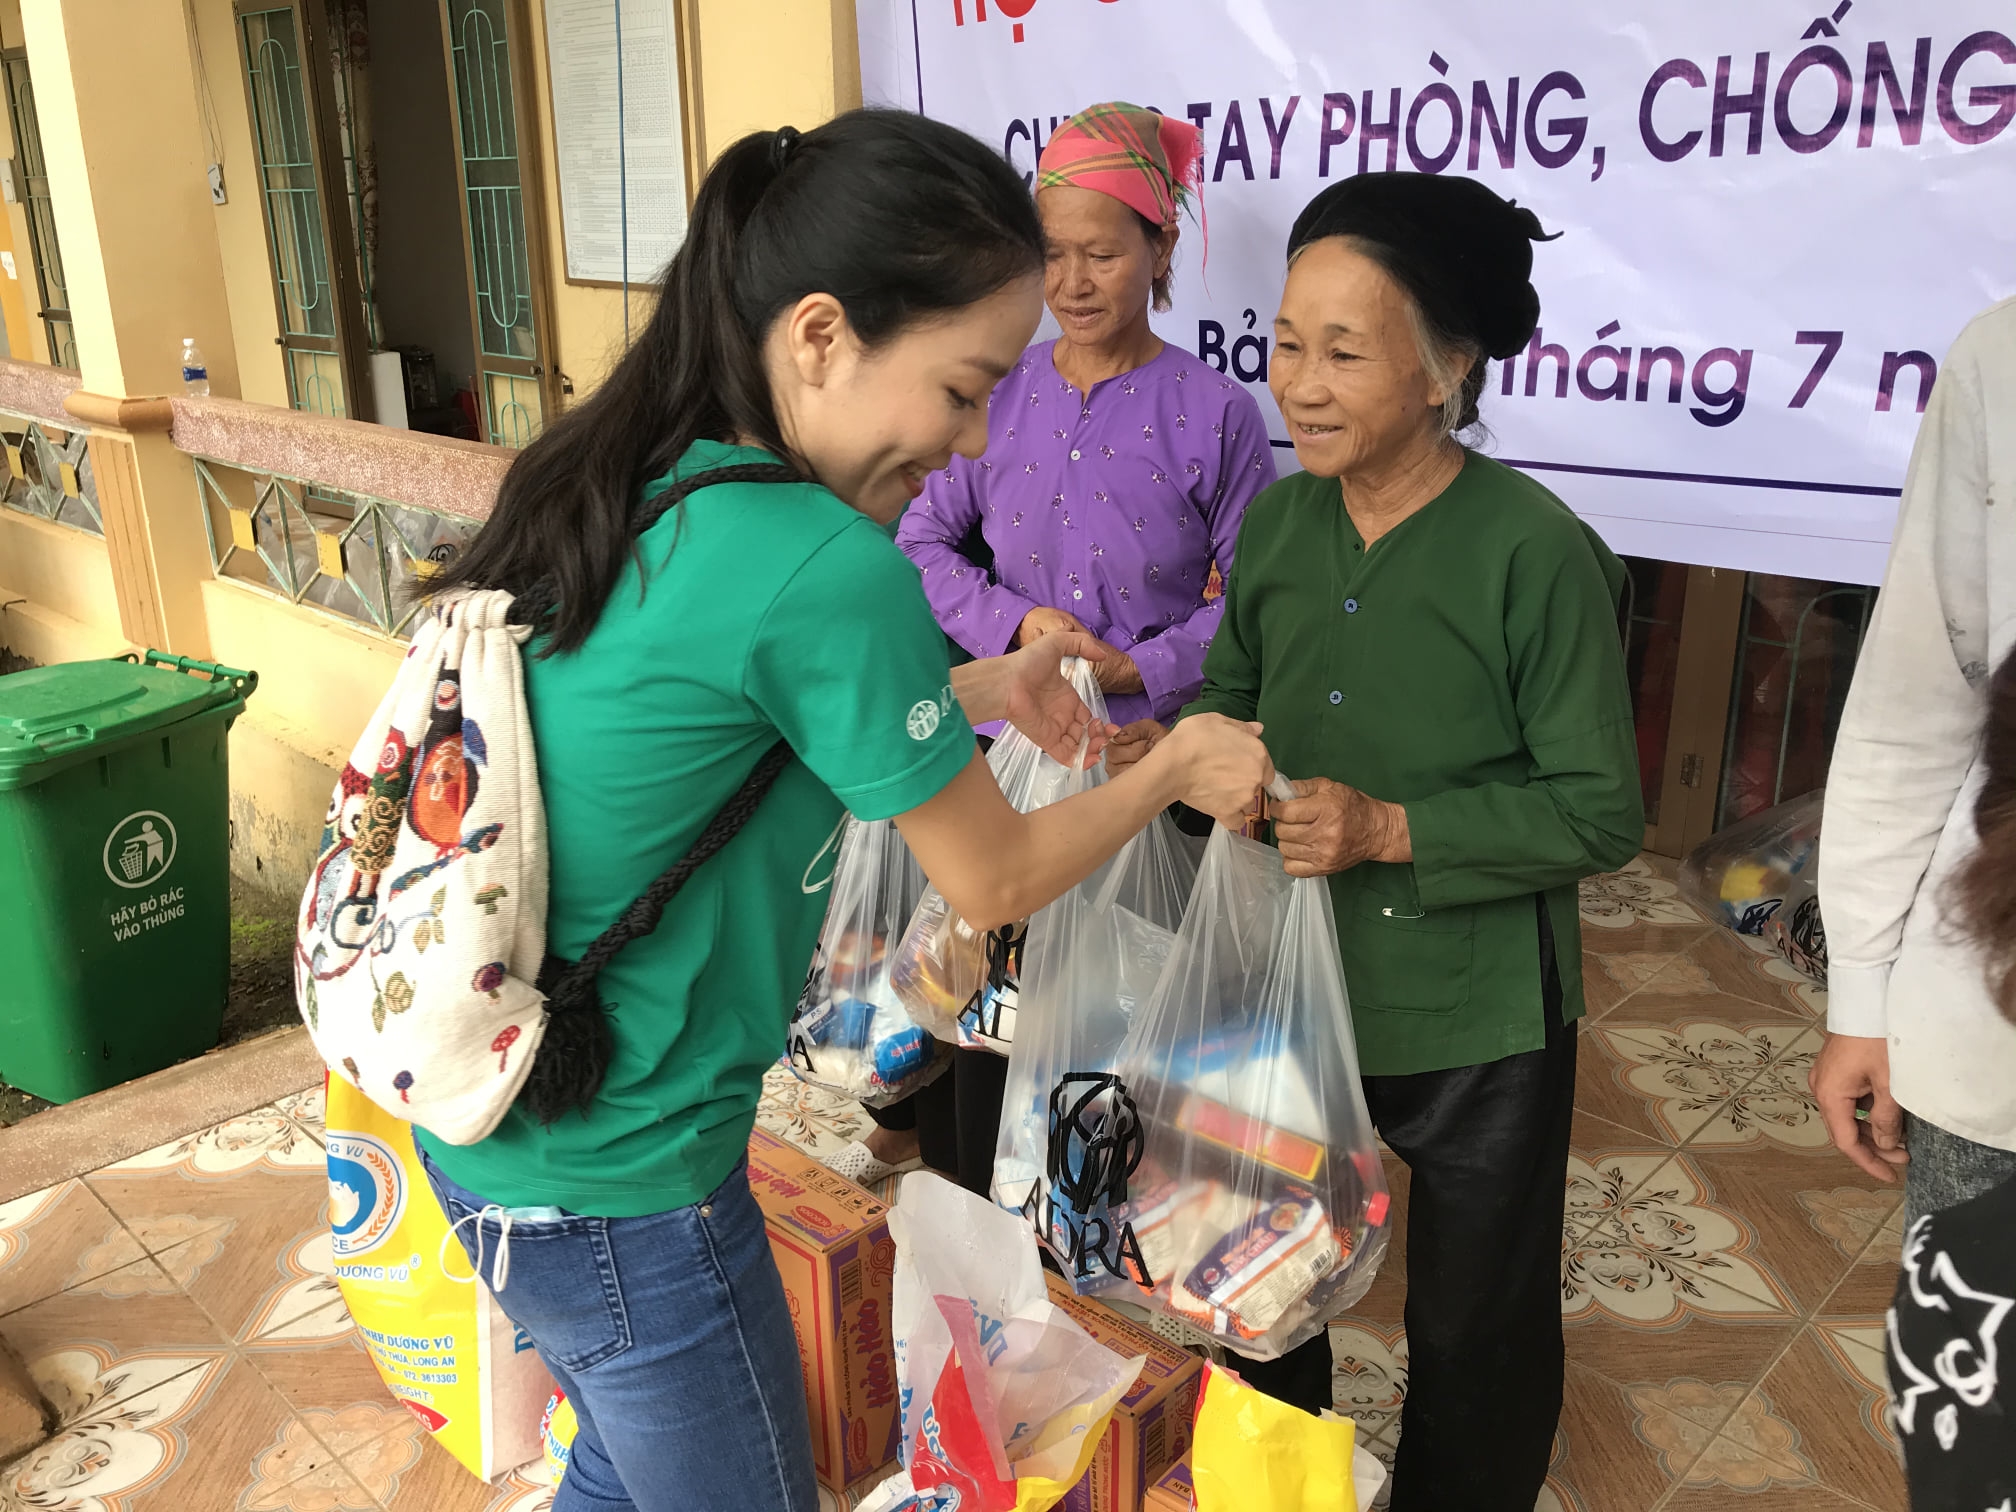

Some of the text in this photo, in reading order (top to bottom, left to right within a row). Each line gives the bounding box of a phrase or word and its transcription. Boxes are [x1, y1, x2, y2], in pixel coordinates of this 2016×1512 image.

[1187, 95, 1301, 183] TAY
[1318, 50, 1606, 183] PHÒNG,
[1639, 0, 2016, 163] CHỐNG
[1199, 308, 1268, 384] Bả
[1787, 330, 1844, 409] 7
[110, 887, 185, 926] HÃY BỎ RÁC
[114, 904, 185, 942] VÀO THÙNG
[1018, 1176, 1155, 1288] ADRA
[387, 1335, 430, 1350] DƯƠNG
[433, 1335, 453, 1349] VŨ
[413, 1357, 438, 1367] LONG
[441, 1356, 455, 1366] AN
